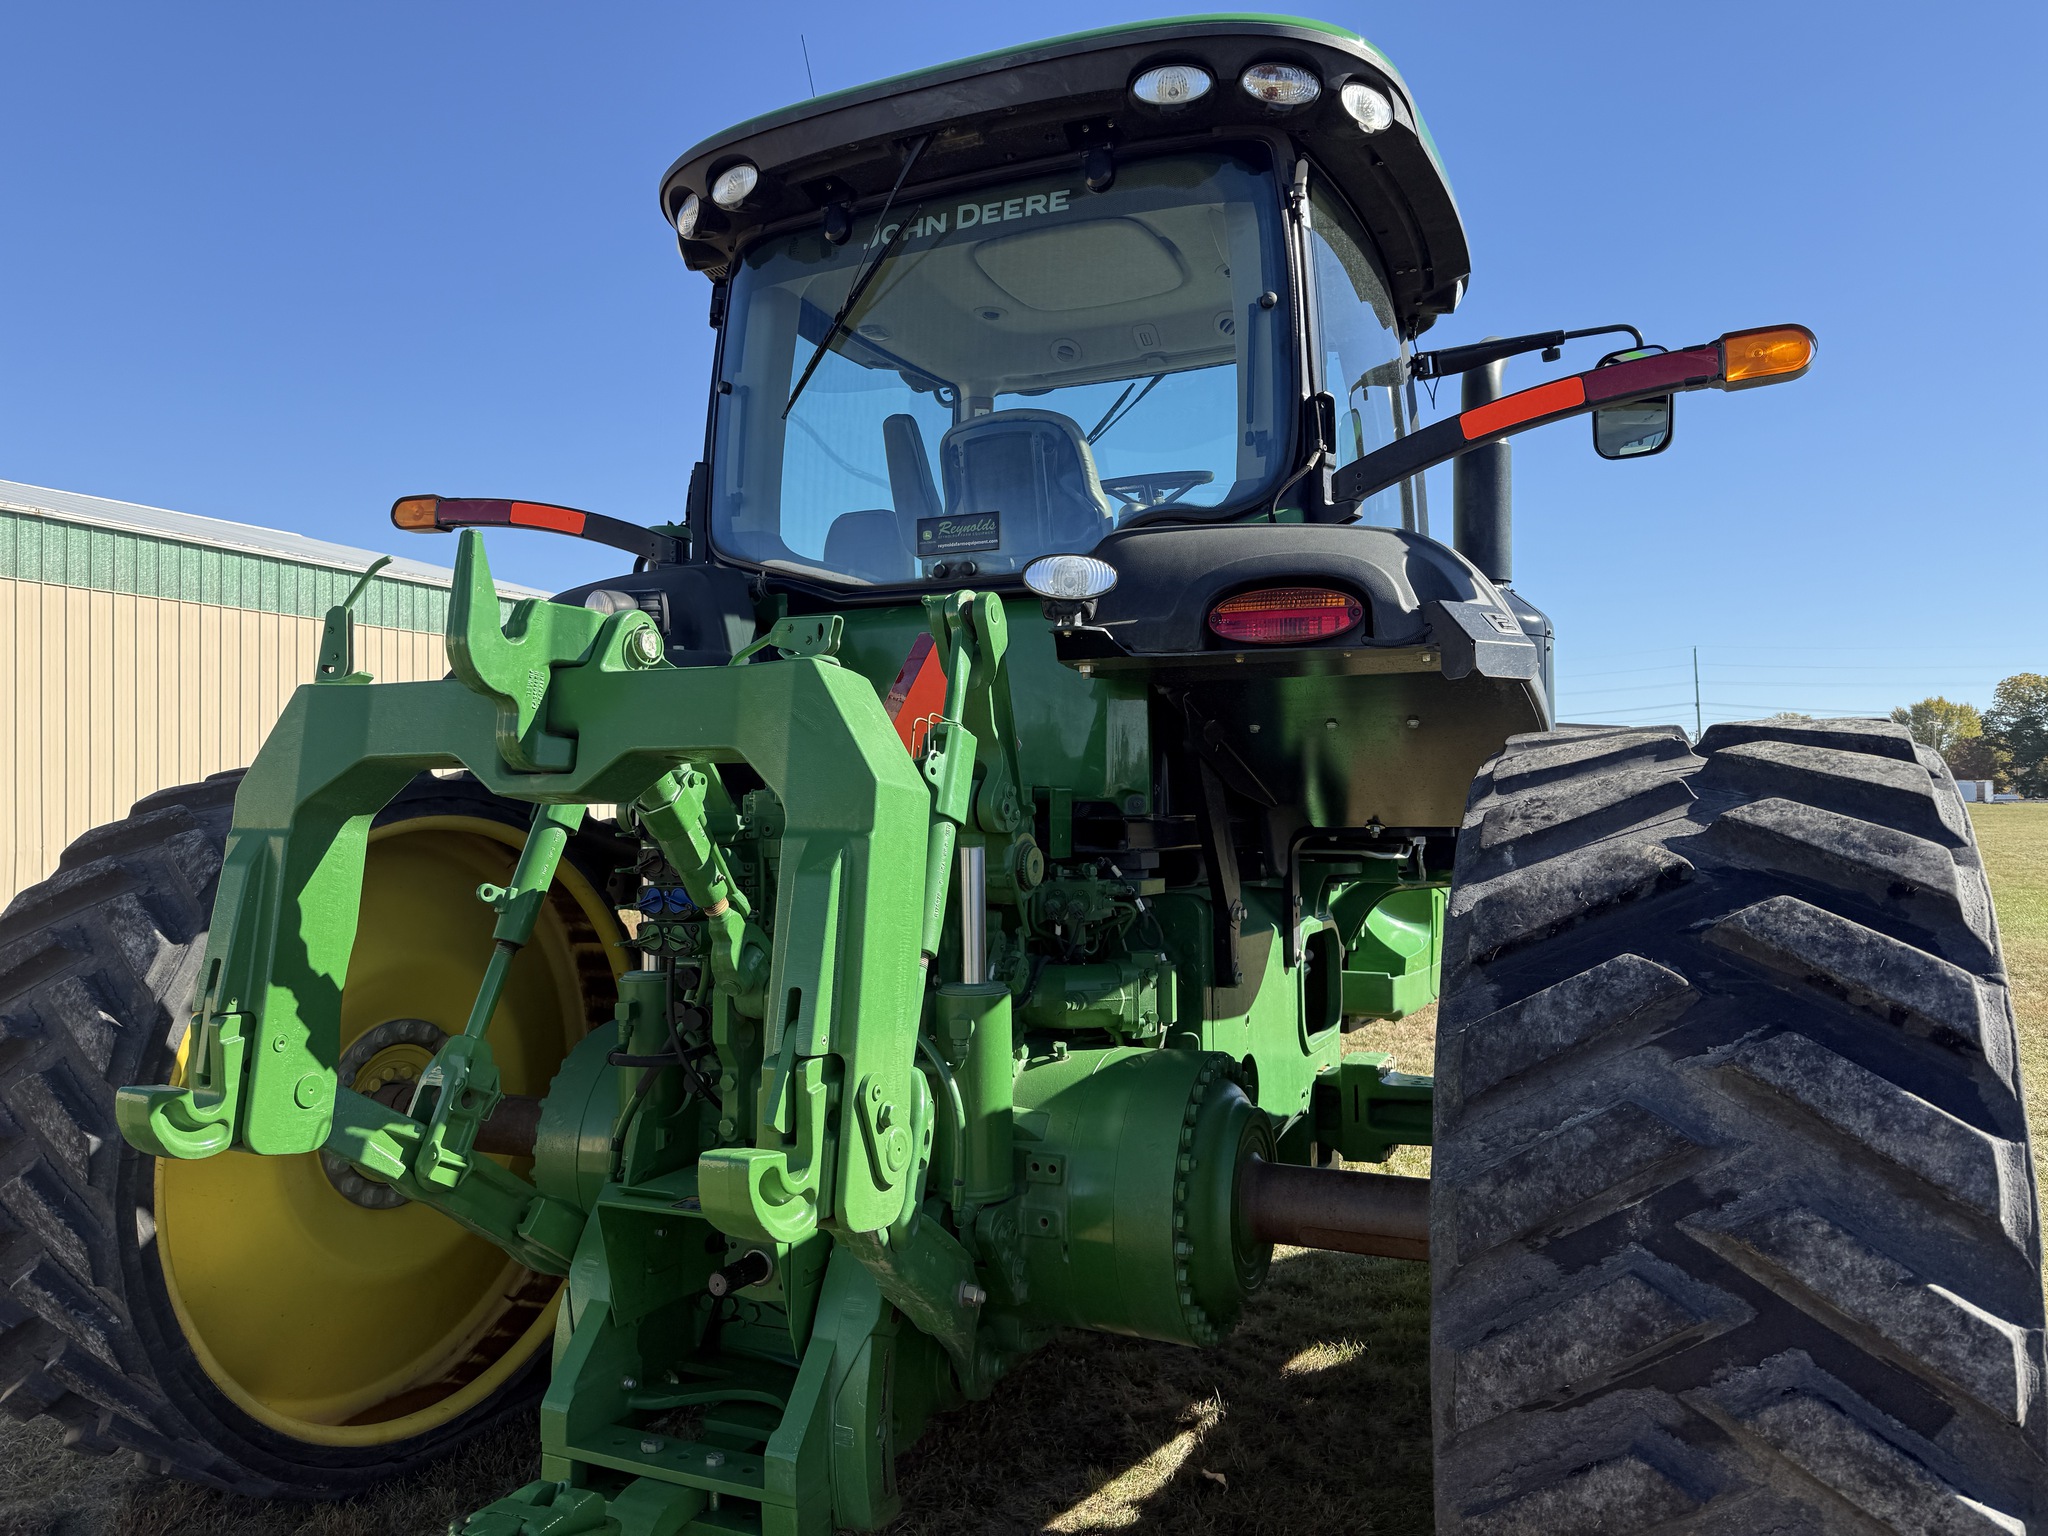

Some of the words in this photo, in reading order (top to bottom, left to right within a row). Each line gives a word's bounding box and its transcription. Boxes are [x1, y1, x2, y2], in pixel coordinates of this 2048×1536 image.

[863, 212, 947, 250] JOHN
[957, 189, 1071, 230] DEERE
[938, 518, 997, 537] Reynolds
